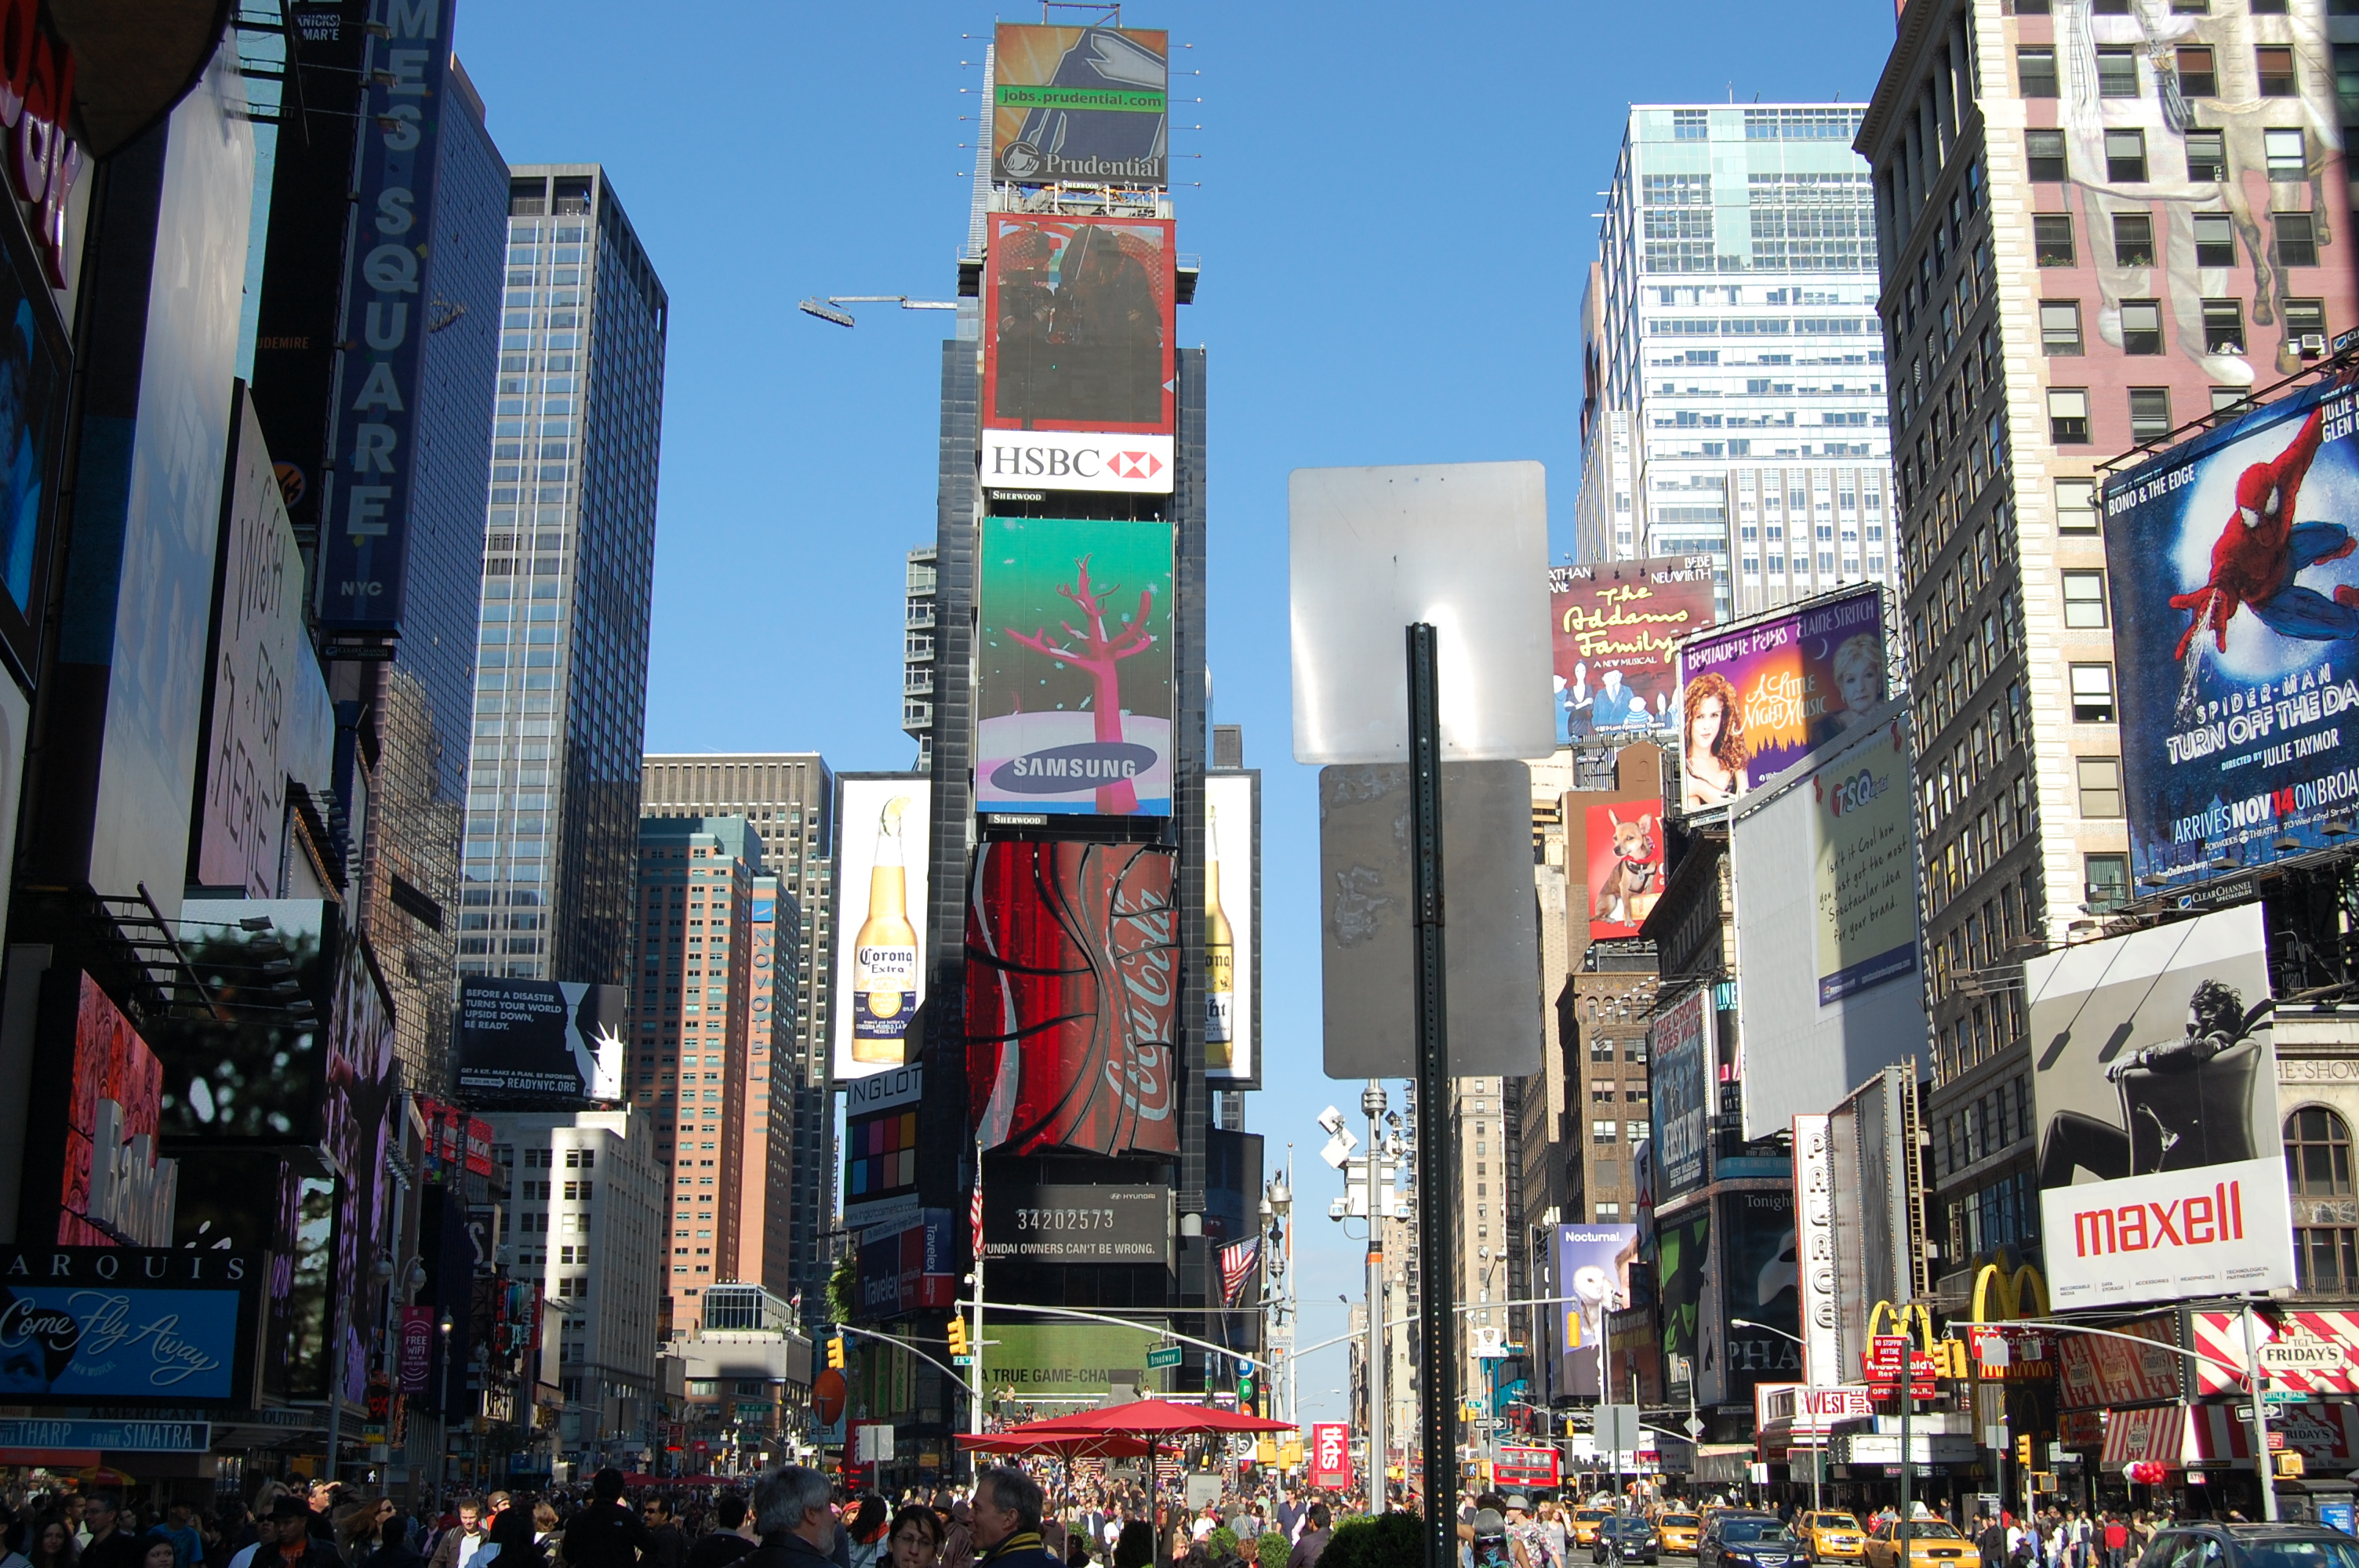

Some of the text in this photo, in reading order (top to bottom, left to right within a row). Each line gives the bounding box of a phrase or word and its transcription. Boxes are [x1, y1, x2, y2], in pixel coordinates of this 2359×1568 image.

[1002, 88, 1162, 107] jobs.prudential.com
[1044, 154, 1160, 177] Prudential
[346, 187, 420, 536] SQUARE
[2321, 394, 2352, 425] JULIE
[2322, 415, 2353, 444] GLEN
[992, 445, 1101, 477] HSBC
[992, 490, 1041, 501] SHERWOOD
[2108, 463, 2195, 517] BONO & THE EDGE
[1684, 555, 1710, 569] BEBE
[340, 581, 383, 597] NYC
[1651, 568, 1711, 585] NEUWIRTH
[1596, 584, 1654, 607] The
[1563, 603, 1689, 633] Addams
[1797, 599, 1874, 639] ELAINE STRITCH
[1574, 630, 1678, 665] Family
[1688, 627, 1788, 670] BERNADETTE PETERS
[1621, 655, 1657, 666] MUSICAL
[1747, 671, 1816, 704] A LITTLE
[1732, 695, 1828, 735] NIGHT MUSIC
[2166, 721, 2226, 765] TURN
[2227, 706, 2274, 745] OFF
[2275, 690, 2321, 731] THE
[2222, 728, 2340, 771] DIRECTED BY JULIE TAYMOR
[1012, 756, 1136, 779] SAMSUNG
[1836, 775, 1872, 817] TSQ
[994, 815, 1041, 826] SHERWOOD
[2174, 806, 2231, 846] ARRIVES
[2231, 793, 2273, 829] NOV
[2271, 787, 2295, 817] 14
[2295, 782, 2317, 811] ON
[2295, 816, 2311, 829] West
[2312, 811, 2329, 824] 42nd
[1826, 822, 1895, 877] Isn't it Cool how
[2205, 834, 2238, 852] FOXWOODS
[1819, 833, 1908, 911] you just got the most
[1828, 869, 1902, 924] Spectacular idea
[2193, 880, 2252, 903] CLEARCHANNEL
[2215, 890, 2252, 902] SPECTACOLOR
[1834, 895, 1898, 945] for your brand.
[860, 947, 913, 967] Corona
[871, 964, 905, 974] Extra
[465, 999, 562, 1014] TURNS YOUR WORLD
[466, 989, 500, 999] BEFORE
[512, 992, 554, 1003] DISASTER
[749, 927, 771, 1081] NOVOTEL
[464, 1009, 535, 1023] UPSIDE DOWN,
[464, 1020, 510, 1031] BE READY.
[1656, 1015, 1672, 1036] THE
[1656, 1015, 1701, 1058] GOES WILD
[507, 1076, 576, 1093] READYNYC.ORG
[544, 1072, 577, 1081] INFORMED.
[847, 1066, 923, 1106] INGLOT
[1662, 1106, 1707, 1167] JERSEY BOYS
[1744, 1194, 1794, 1211] Tonight
[1807, 1133, 1837, 1329] PALACE
[2074, 1180, 2244, 1258] maxell
[926, 1224, 937, 1272] Travelex
[1020, 1243, 1063, 1255] OWNERS
[1066, 1243, 1096, 1255] CAN'T
[1099, 1243, 1112, 1254] BE
[1114, 1243, 1155, 1255] WRONG.
[1565, 1231, 1623, 1243] Nocturnal.
[7, 1253, 245, 1281] ARQUIS
[863, 1269, 900, 1306] Travelex
[0, 1290, 220, 1386] Come Fly Away
[405, 1335, 427, 1345] FREE
[407, 1345, 425, 1355] WIFI
[1150, 1352, 1176, 1366] Broadway
[1728, 1339, 1801, 1371] PHA
[2266, 1346, 2339, 1362] FRIDAY'S
[86, 1359, 117, 1377] MUSICAL
[981, 1369, 1028, 1383] A TRUE
[89, 1406, 197, 1421] AMERICAN
[1804, 1389, 1865, 1416] WEST SIDE
[18, 1421, 72, 1446] THARP
[91, 1423, 193, 1449] FRANK SINATRA
[1321, 1425, 1343, 1470] tkts
